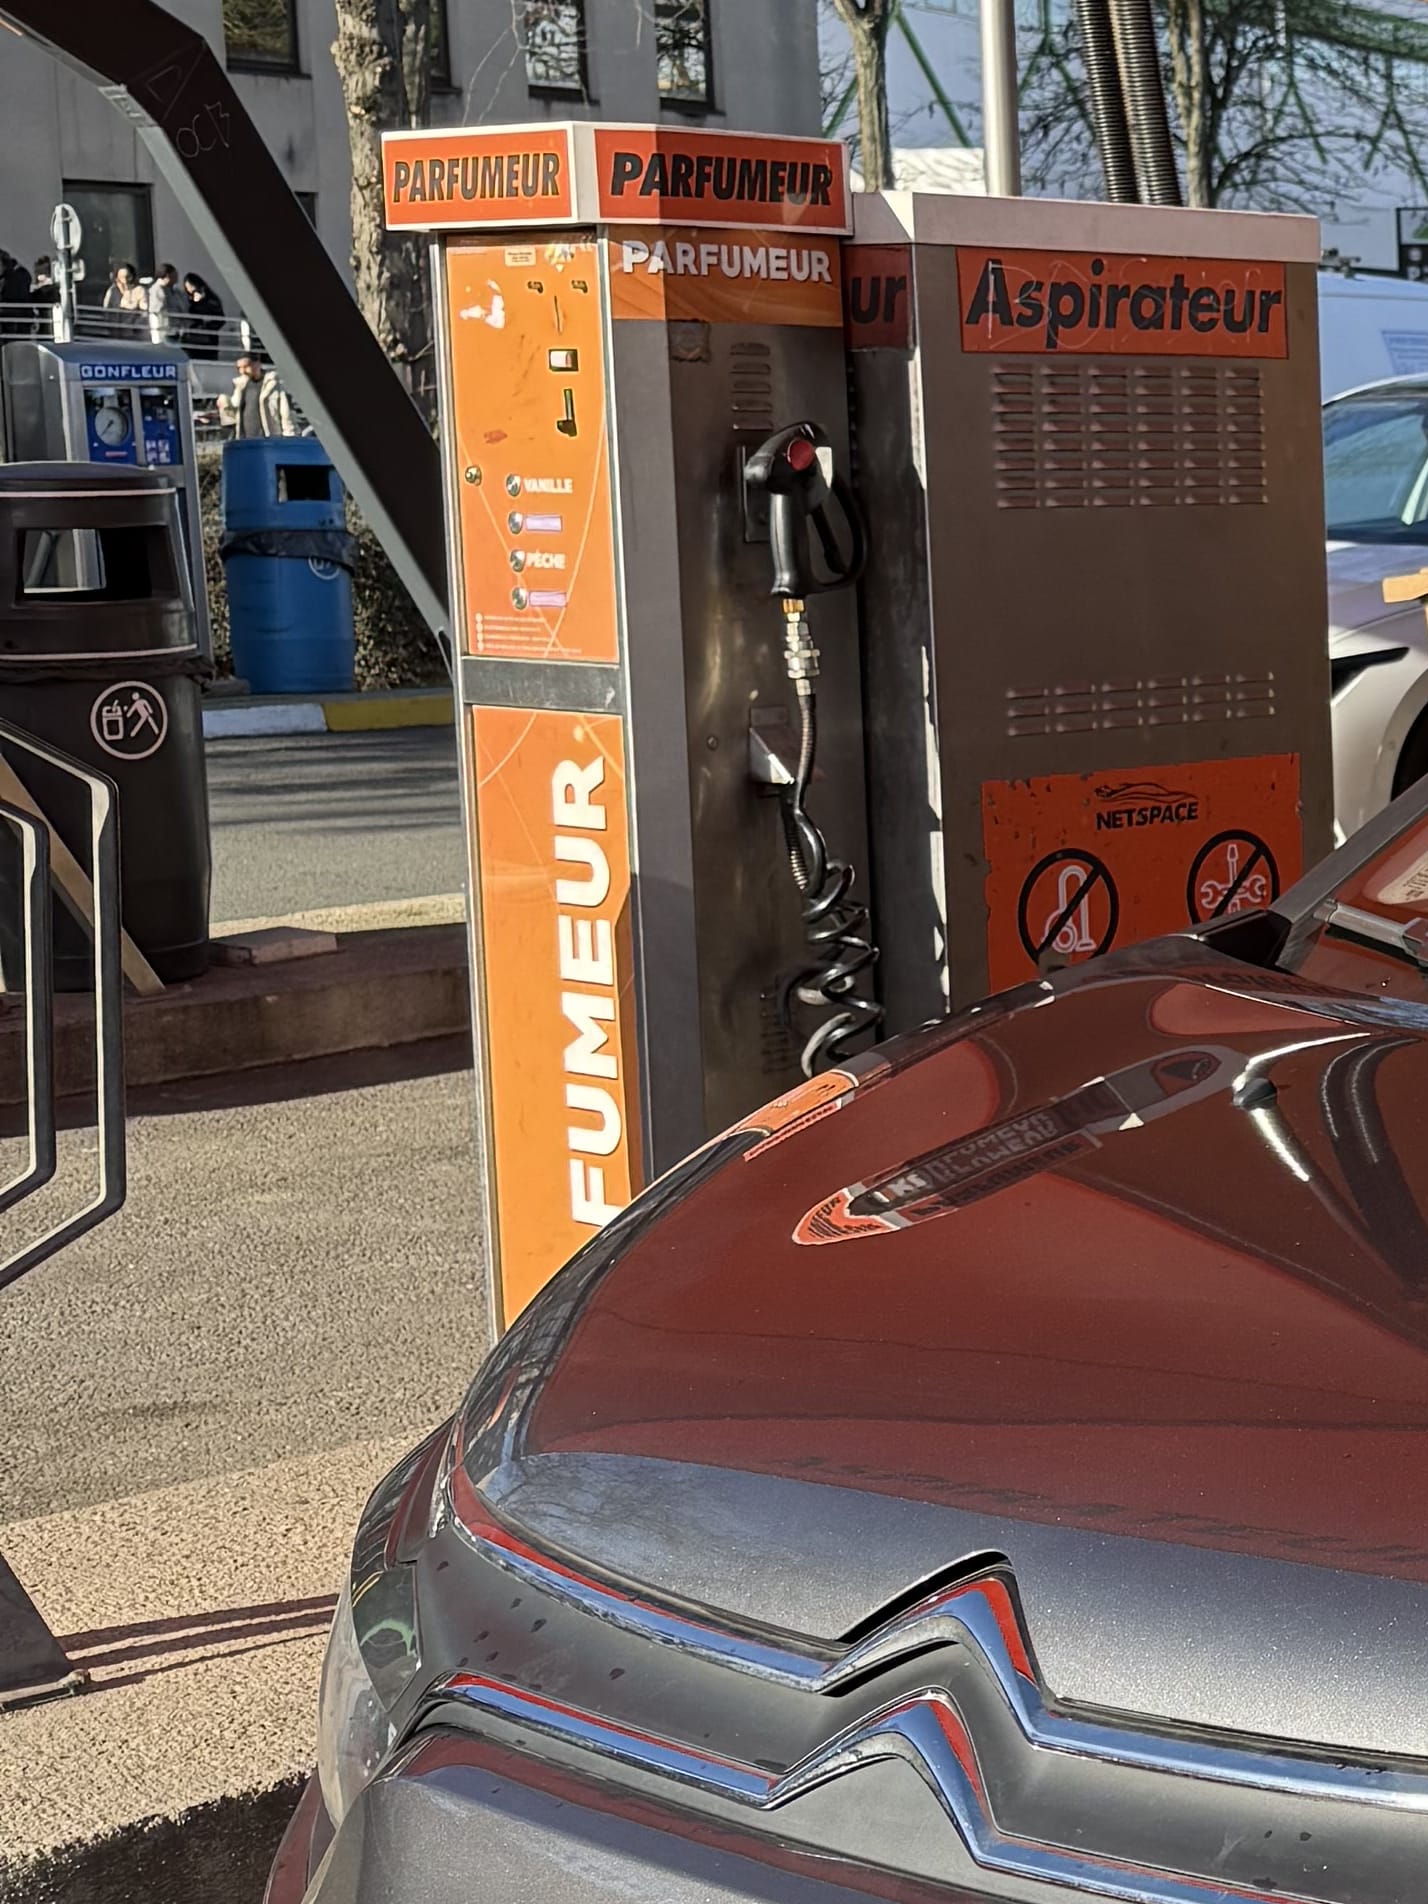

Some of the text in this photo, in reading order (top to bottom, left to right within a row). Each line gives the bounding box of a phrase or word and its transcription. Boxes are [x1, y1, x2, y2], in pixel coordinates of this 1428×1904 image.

[393, 151, 560, 203] PARFUMEUR
[611, 151, 833, 207] PARFUMEUR
[622, 240, 833, 283] PARFUMEUR
[965, 258, 1282, 349] Aspirateur
[81, 365, 176, 379] GONFLEUR
[523, 477, 573, 493] VANILLE
[1096, 800, 1199, 831] NETSPACE
[552, 755, 628, 1227] FUMEUR
